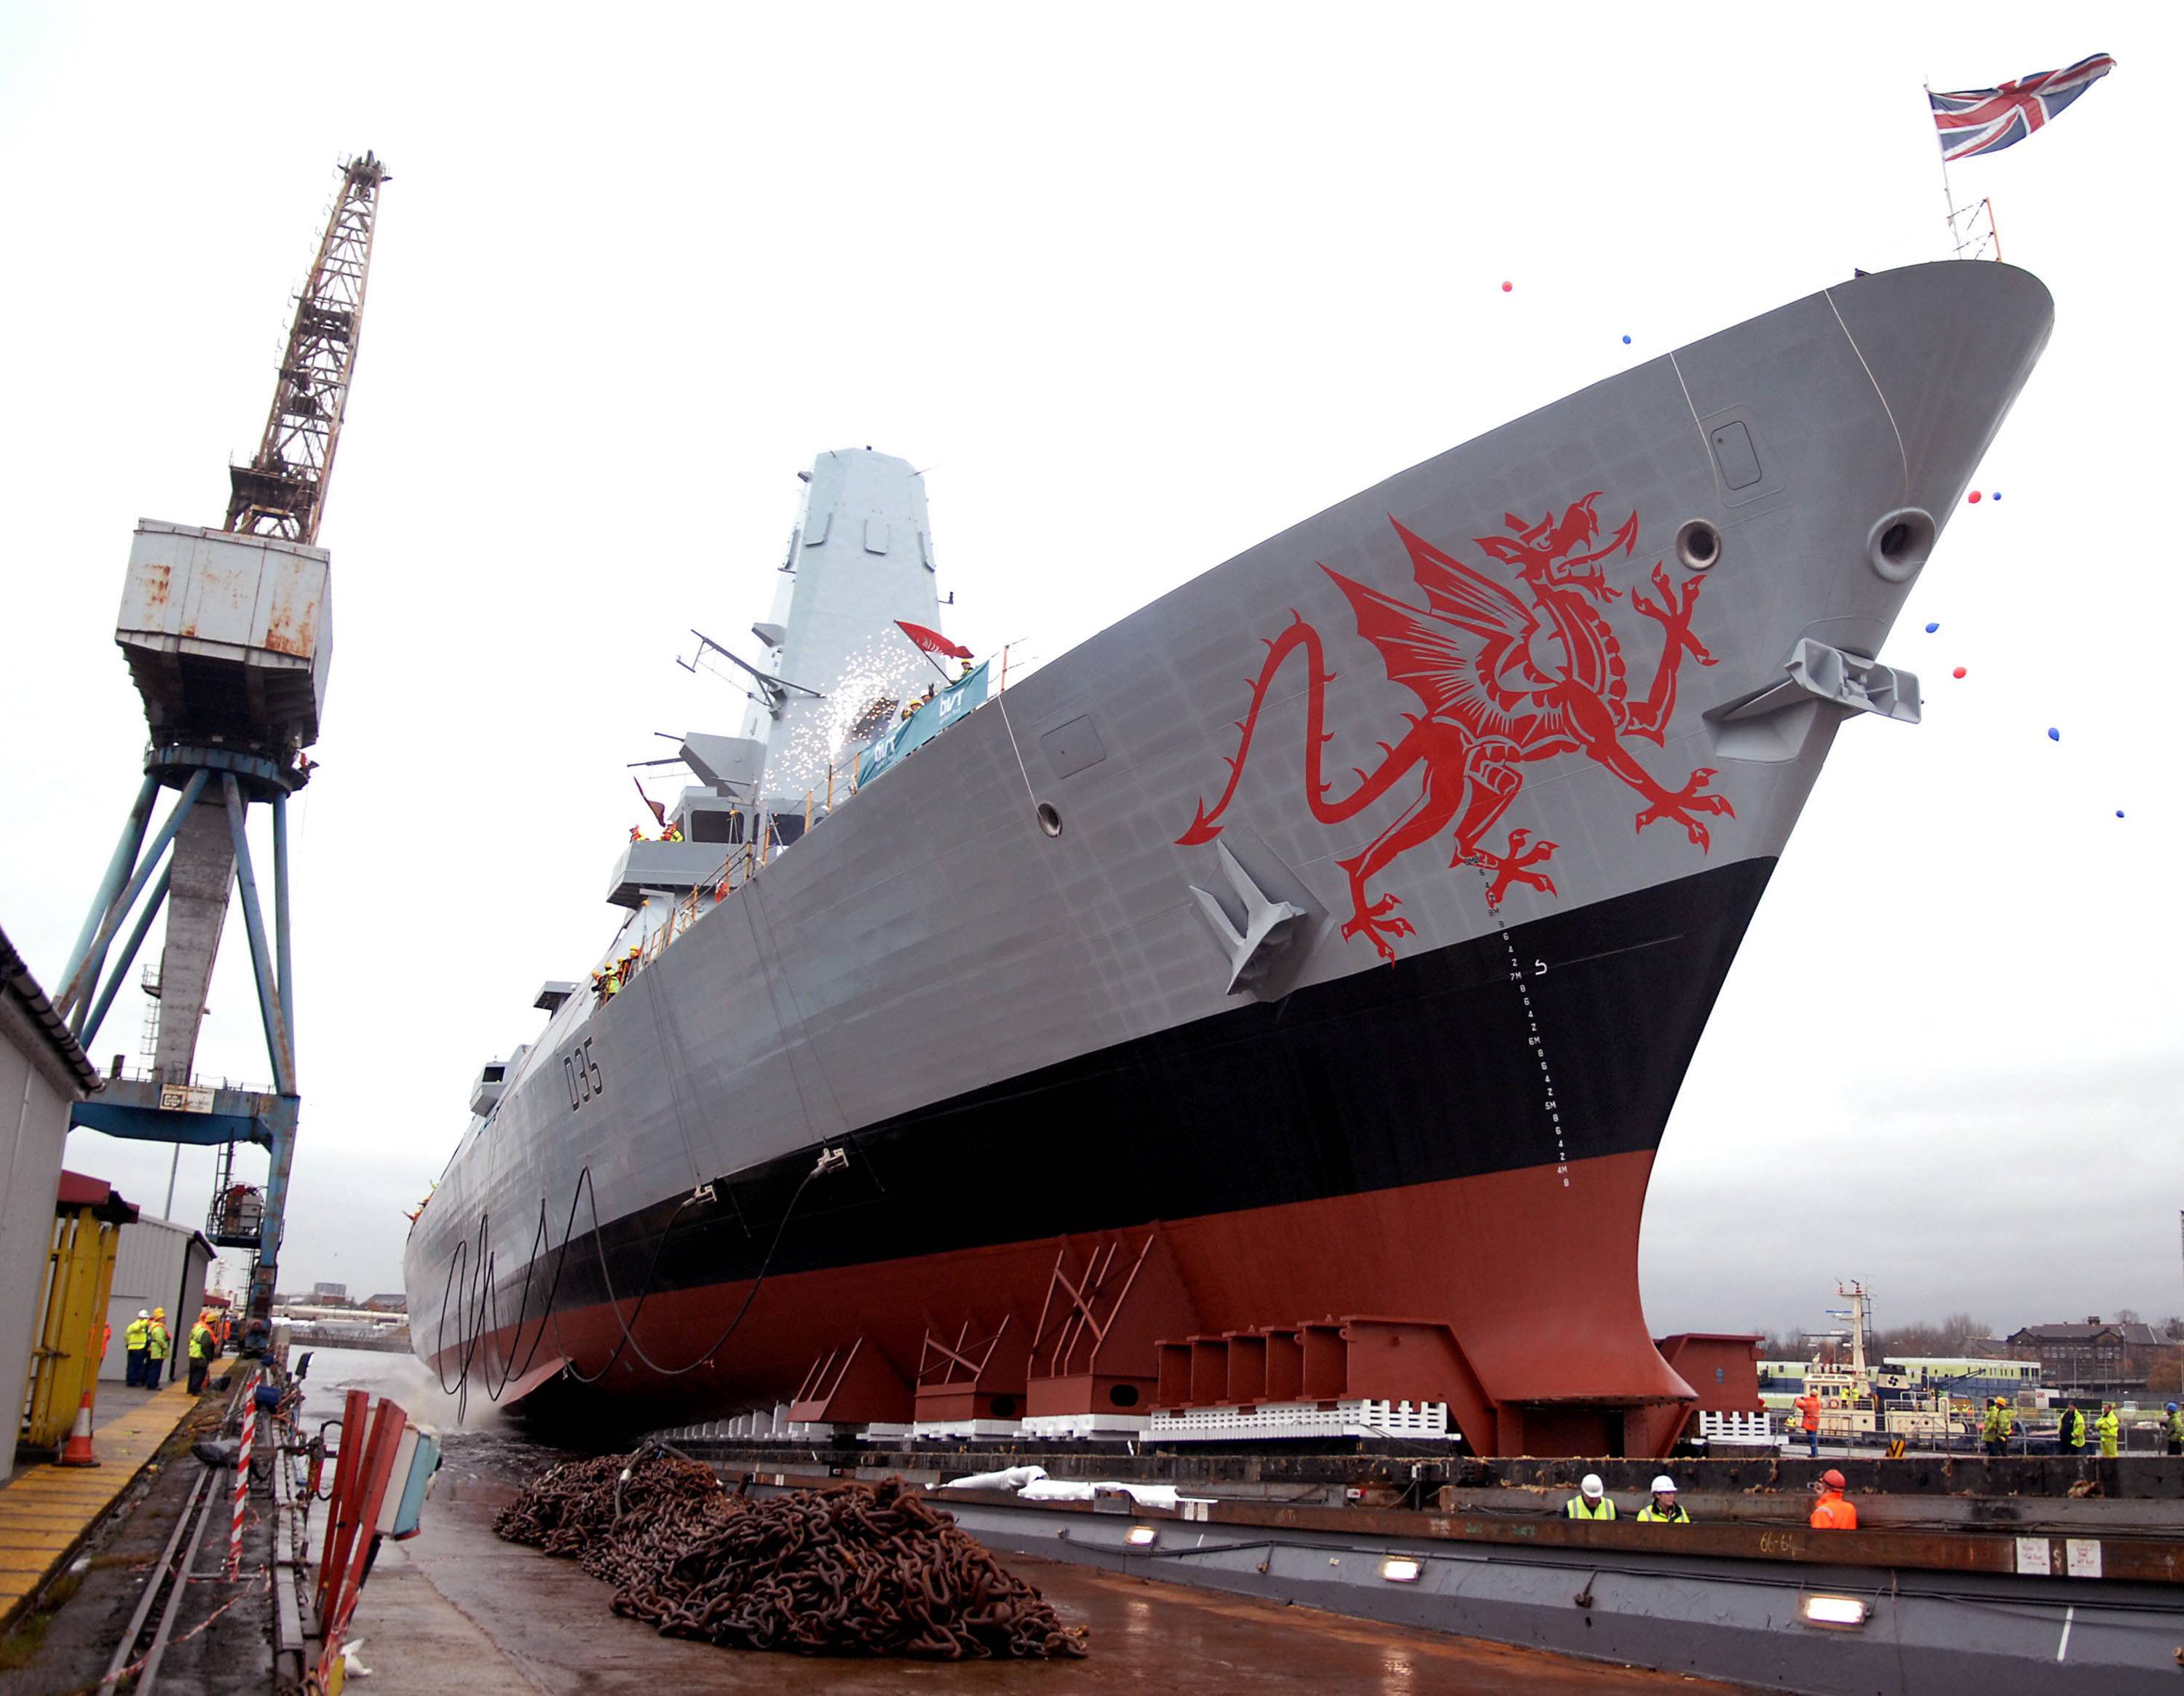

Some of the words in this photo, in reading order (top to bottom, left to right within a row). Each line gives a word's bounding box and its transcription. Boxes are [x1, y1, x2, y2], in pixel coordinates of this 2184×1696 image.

[1511, 959, 1518, 967] 2
[1510, 971, 1522, 981] 7M
[1519, 984, 1526, 992] 8
[1524, 997, 1530, 1005] 6
[1531, 1023, 1537, 1031] 2
[1529, 1036, 1541, 1045] 6M
[1538, 1049, 1543, 1057] 8
[1540, 1061, 1547, 1070] 6
[563, 1036, 604, 1112] D35
[1545, 1074, 1550, 1082] 4
[1547, 1087, 1554, 1096] 2
[1545, 1101, 1556, 1110] 5M
[1553, 1114, 1559, 1122] 8
[1555, 1126, 1562, 1135] 6
[1558, 1139, 1564, 1148] 4
[1559, 1152, 1565, 1161] 2
[1557, 1165, 1567, 1173] 4M
